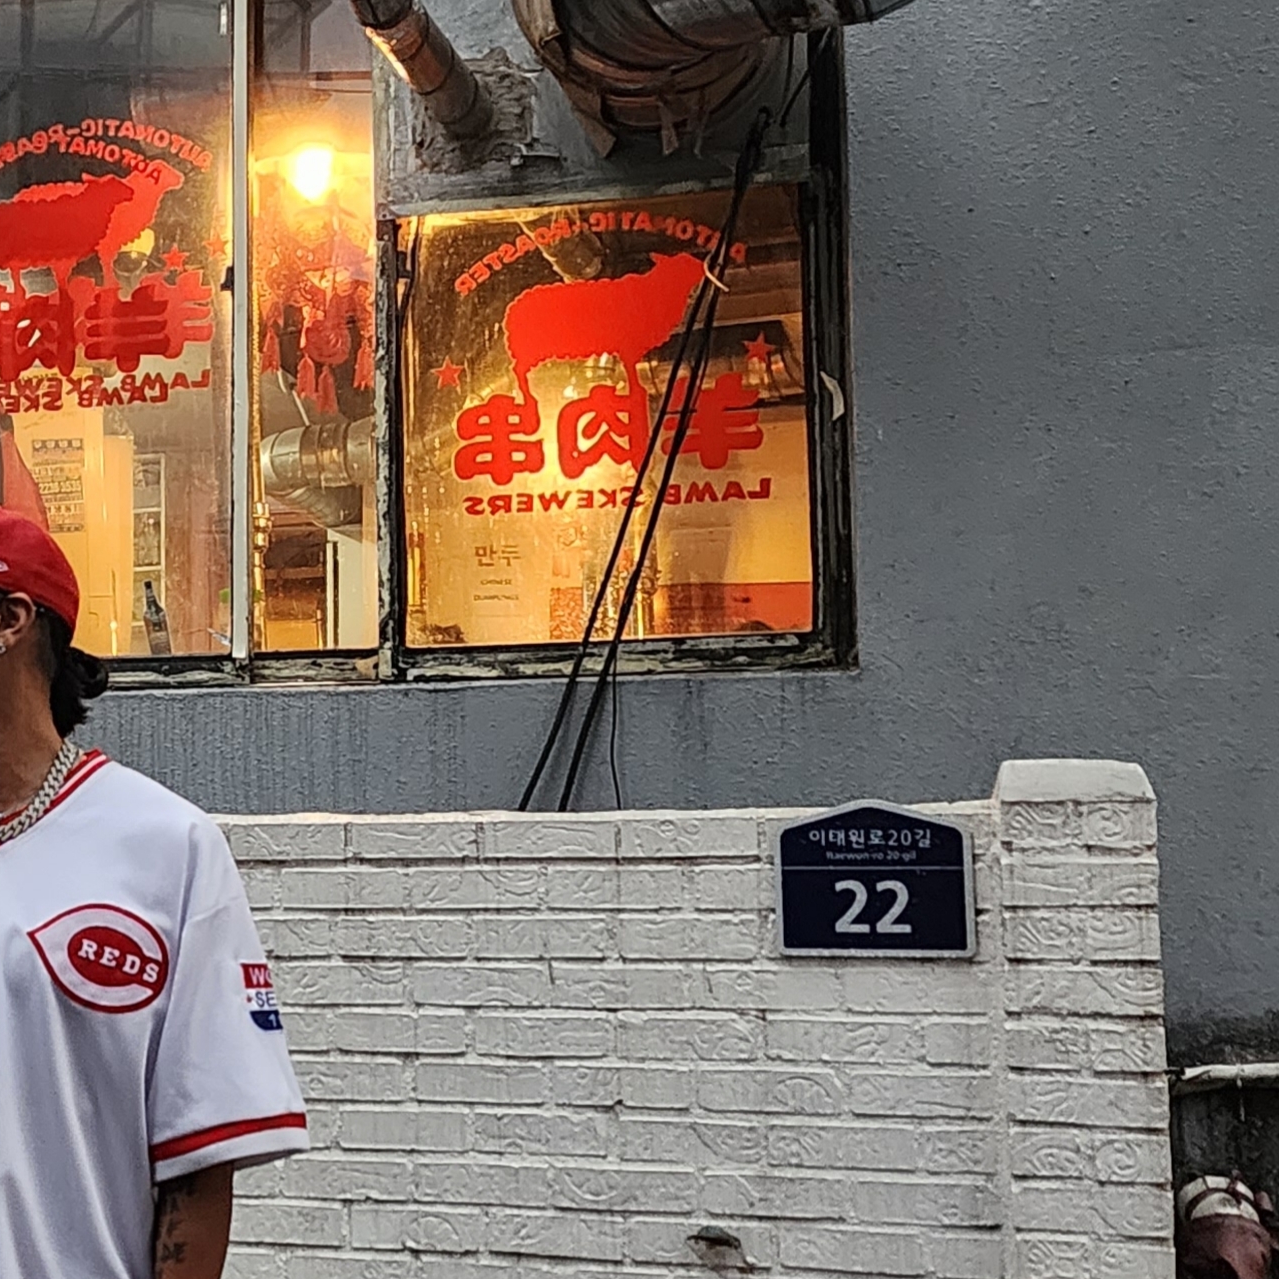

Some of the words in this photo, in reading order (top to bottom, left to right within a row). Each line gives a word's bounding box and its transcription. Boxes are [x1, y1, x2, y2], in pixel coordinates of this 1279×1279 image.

[475, 544, 521, 567] 만두
[809, 828, 931, 849] 이태원로20길
[834, 879, 912, 934] 22
[77, 938, 160, 984] REDS
